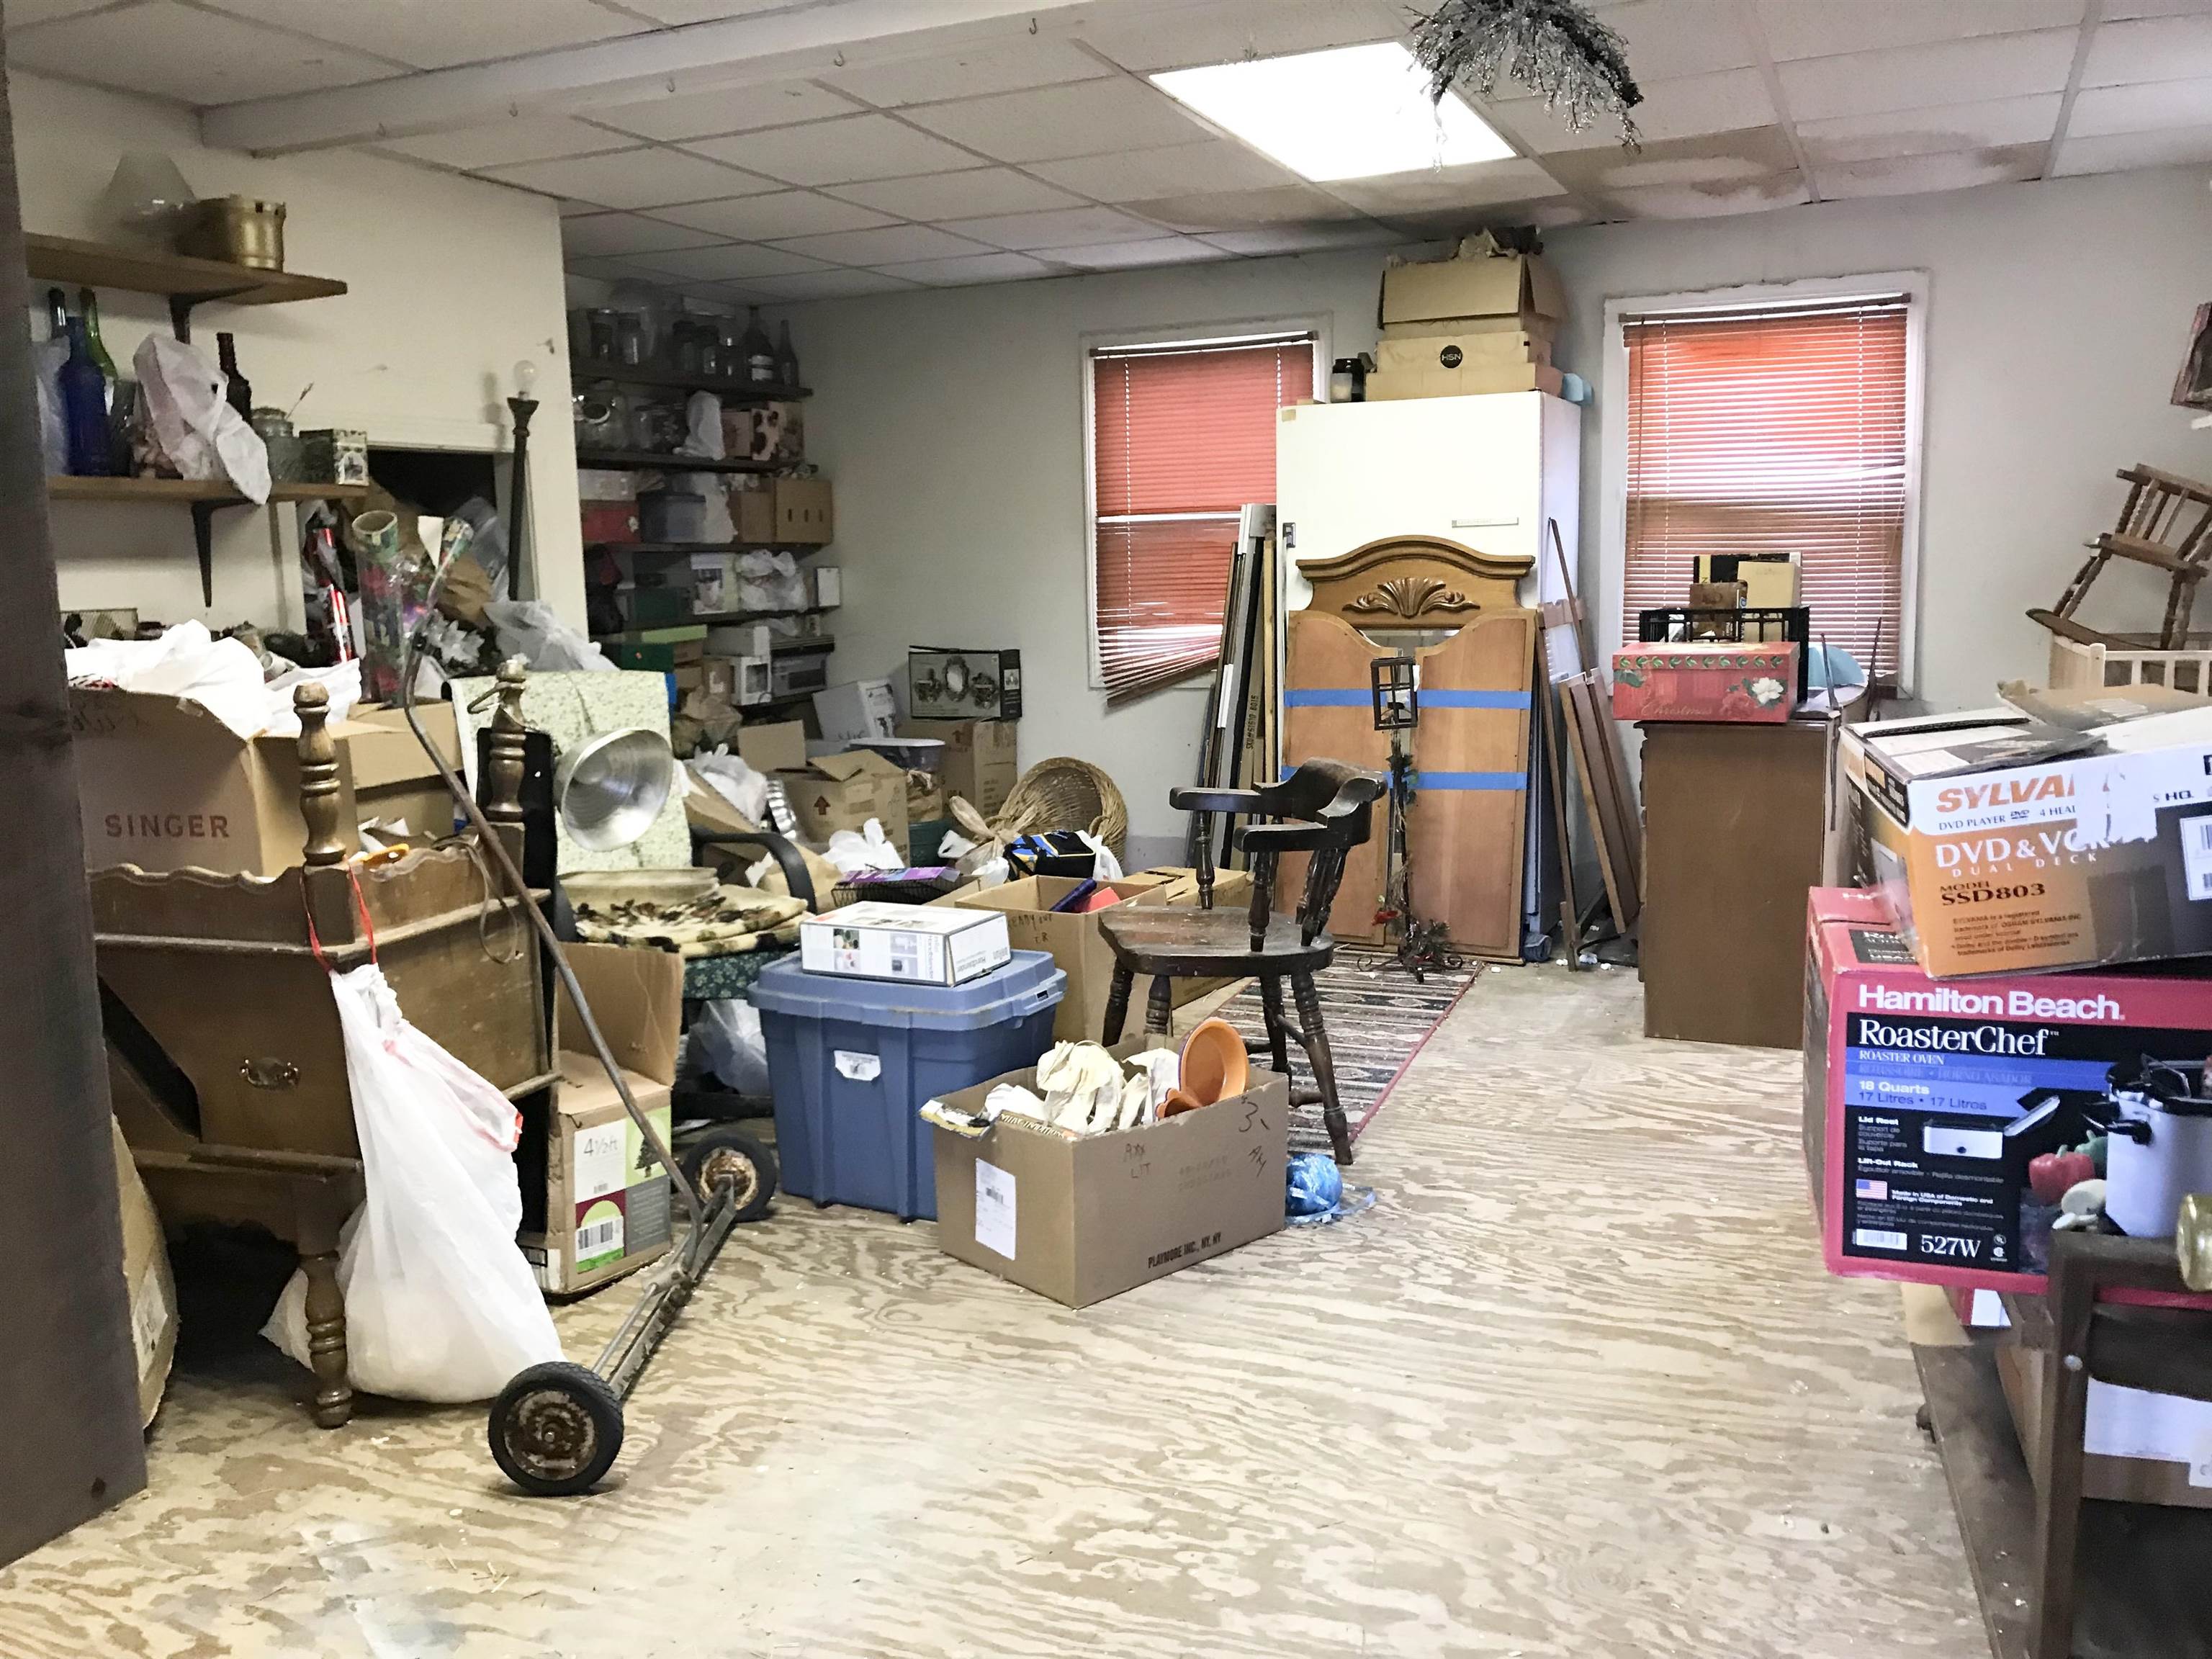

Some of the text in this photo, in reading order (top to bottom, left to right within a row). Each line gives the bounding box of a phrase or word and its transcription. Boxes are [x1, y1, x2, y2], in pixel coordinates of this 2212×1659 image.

[105, 814, 230, 837] SINGER
[1939, 820, 1964, 830] DVD
[1968, 815, 2006, 827] PLAYER
[2040, 808, 2046, 817] 4
[1936, 837, 2011, 868] DVD
[2016, 839, 2036, 858] &
[1952, 853, 2097, 878] DUAL DECK
[1941, 883, 2046, 906] SSD803
[1858, 984, 2003, 1015] Hamilton
[1859, 1019, 2049, 1056] RoasterChef
[1859, 1050, 1944, 1066] ROASTER OVEN
[1859, 1080, 1930, 1094] 18 Quarts
[1859, 1092, 1987, 1110] 17 Litres 17 Litros
[1893, 1160, 1918, 1169] Rack
[1148, 1245, 1182, 1269] PLAYMORE
[1920, 1234, 1981, 1258] 527W
